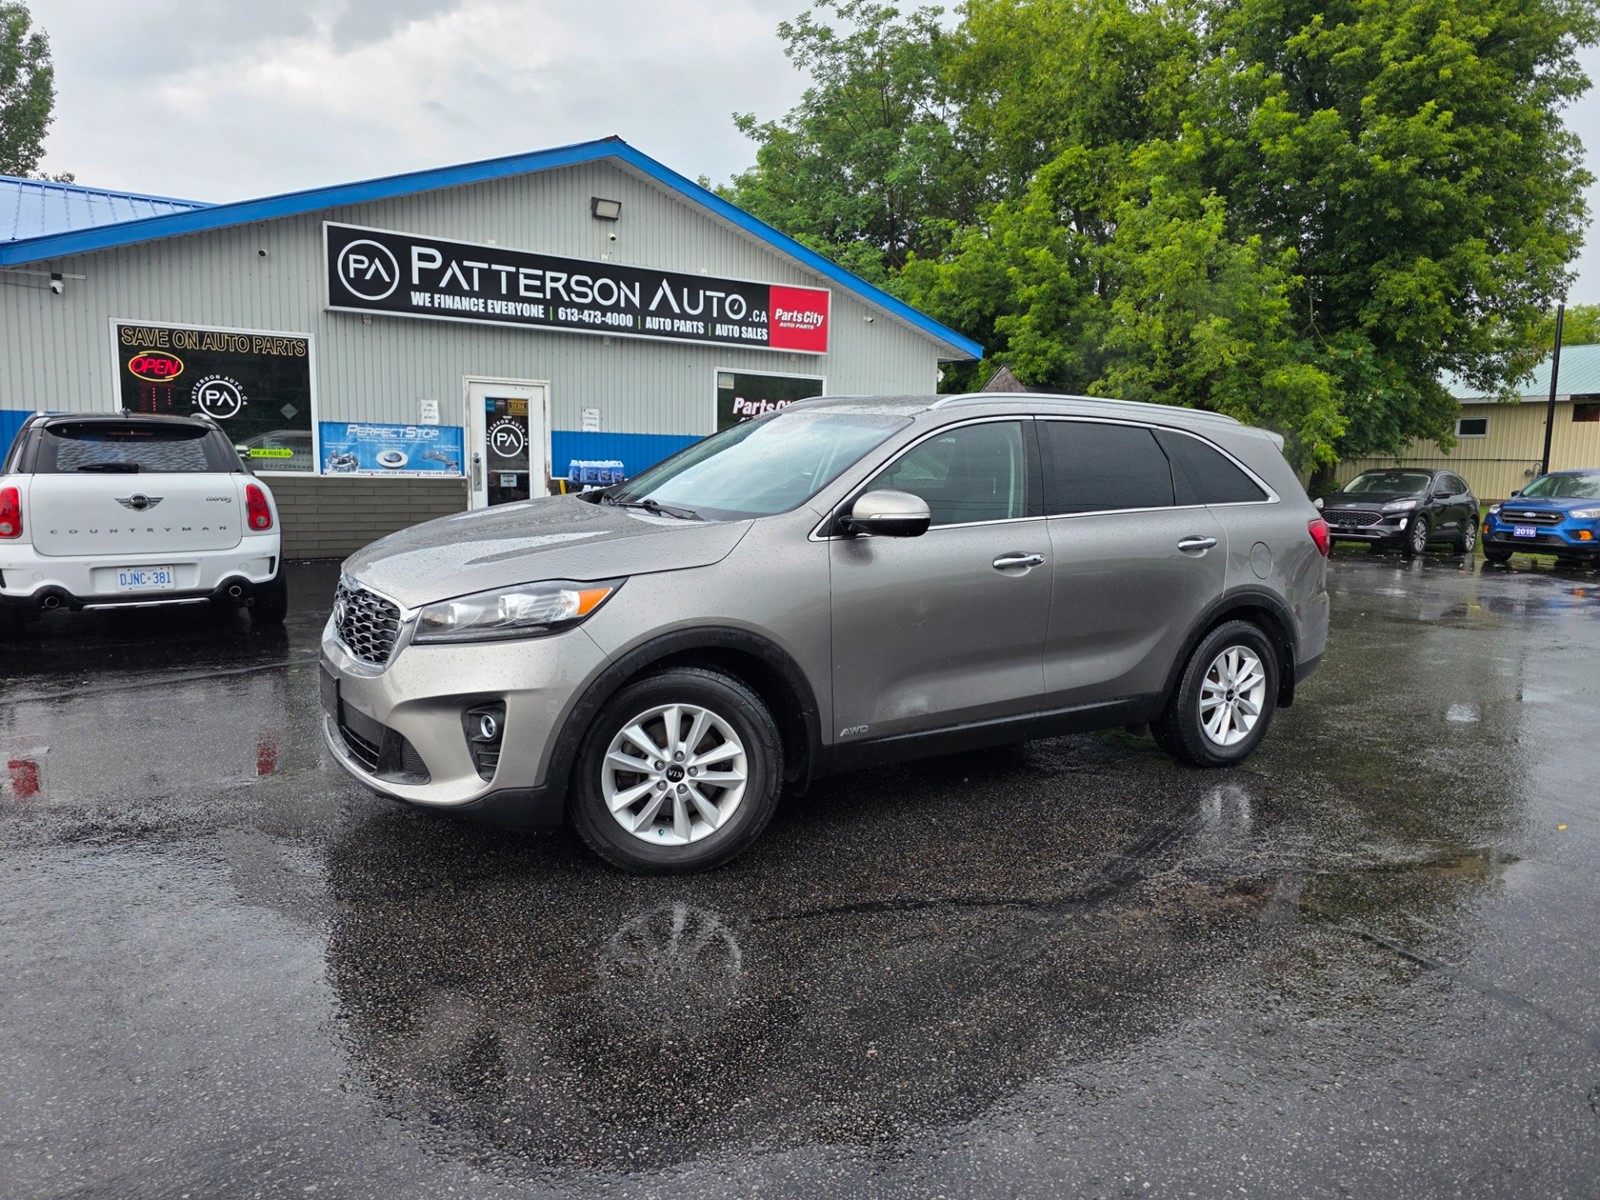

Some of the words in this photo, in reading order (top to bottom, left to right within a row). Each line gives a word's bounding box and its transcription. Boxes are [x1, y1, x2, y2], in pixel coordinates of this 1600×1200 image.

[348, 254, 391, 282] PA
[410, 245, 640, 309] PATTERSON
[410, 291, 432, 307] WE
[434, 294, 485, 312] FINANCE
[487, 299, 545, 318] EVERYONE
[557, 306, 633, 327] 613-473-4000
[645, 316, 671, 332] AUTO
[673, 319, 704, 334] PARTS
[715, 323, 740, 338] AUTO
[741, 326, 768, 341] SALES
[121, 327, 169, 347] SAVE
[172, 330, 199, 349] ON
[202, 332, 249, 352] AUTO
[253, 336, 306, 356] PARTS
[131, 358, 178, 375] OPEN
[191, 374, 220, 405] PATTERSON
[224, 376, 243, 391] AUTO
[205, 390, 236, 407] PA
[346, 424, 439, 439] PERFECTSTOP
[496, 432, 519, 447] PA
[49, 525, 227, 535] COUNTRYMAN
[120, 573, 146, 586] DJNC
[152, 571, 171, 584] 381
[839, 725, 869, 737] AWD
